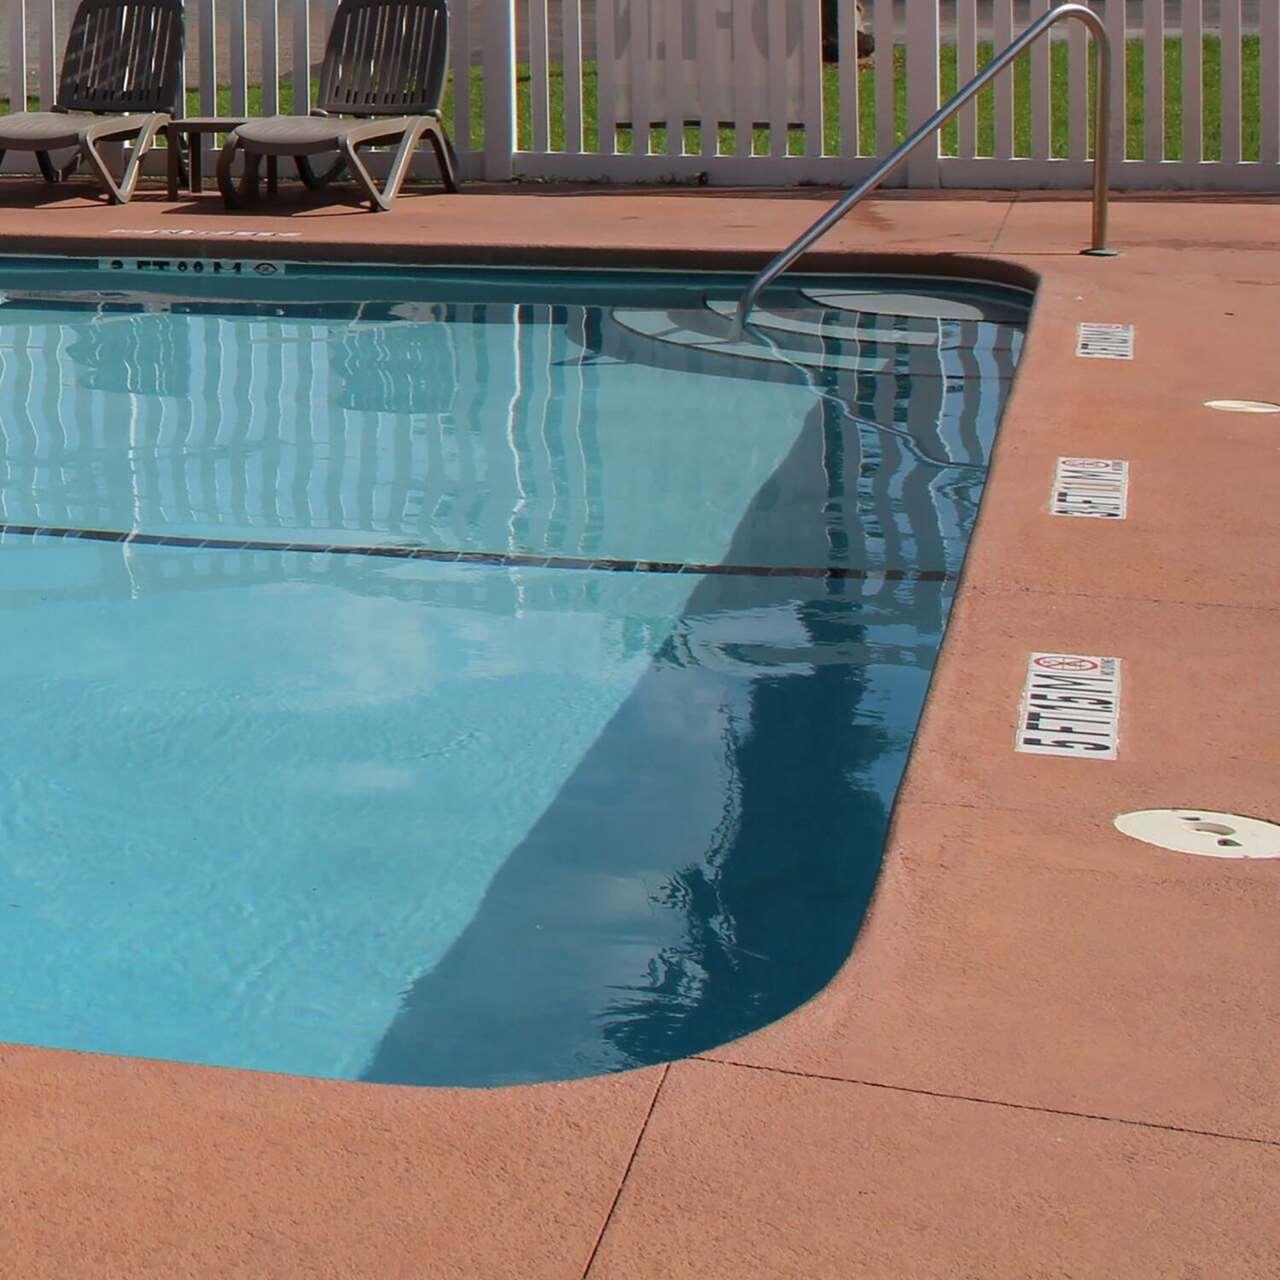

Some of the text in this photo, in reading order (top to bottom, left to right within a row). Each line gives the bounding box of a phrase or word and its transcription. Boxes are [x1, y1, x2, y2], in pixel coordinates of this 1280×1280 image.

[1056, 492, 1121, 506] FT
[1032, 673, 1113, 694] M
[1025, 712, 1111, 737] FT
[1023, 737, 1111, 751] 5
